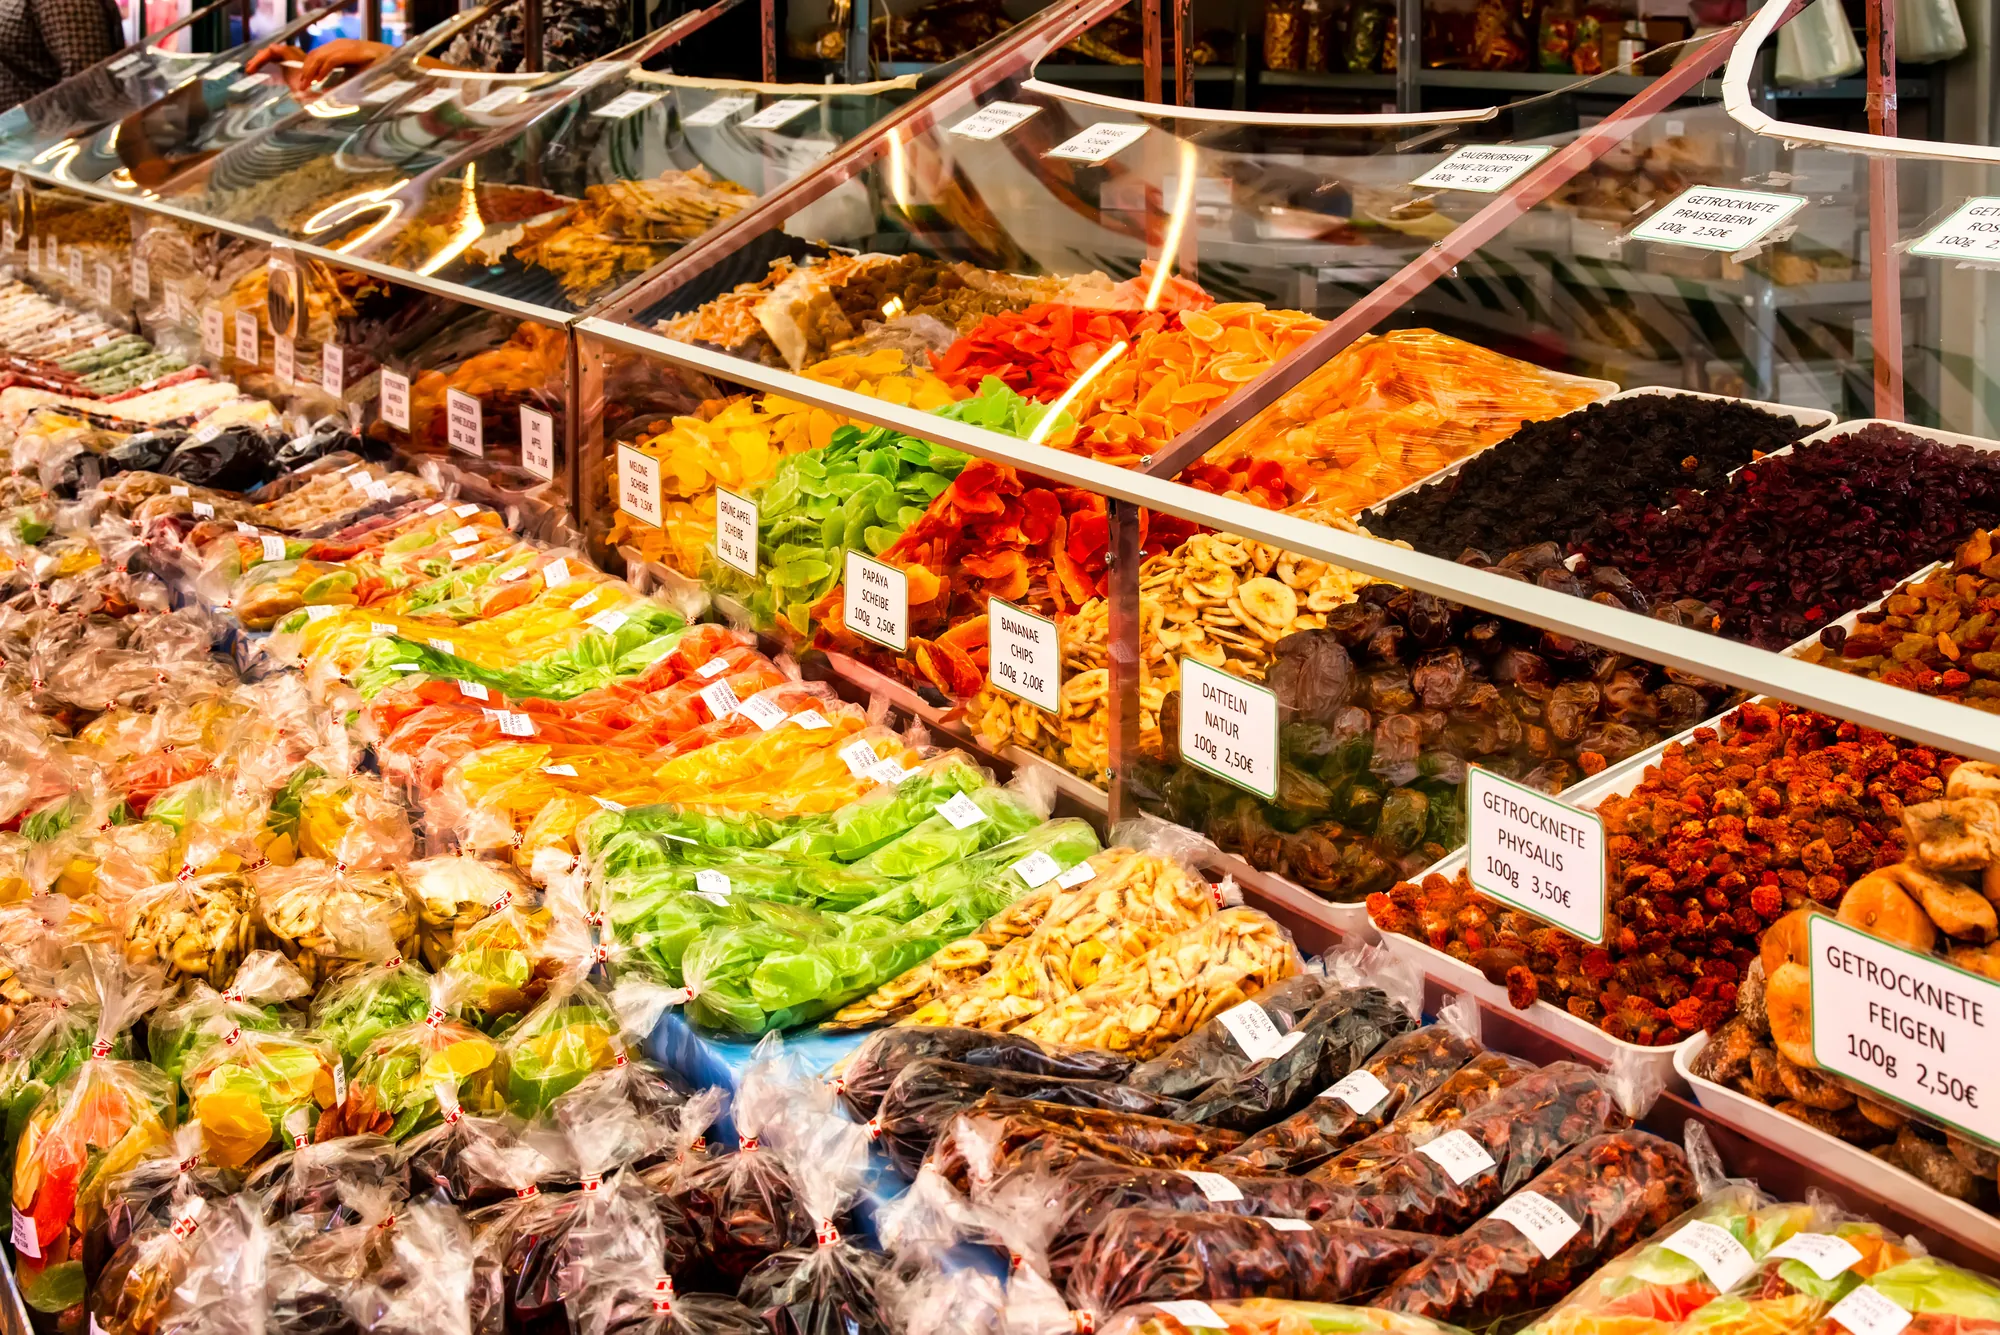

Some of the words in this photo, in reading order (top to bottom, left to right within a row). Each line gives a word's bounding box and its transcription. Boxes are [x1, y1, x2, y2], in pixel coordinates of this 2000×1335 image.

[1443, 163, 1472, 172] OHNE
[1471, 164, 1513, 173] ZUCKER
[1457, 151, 1533, 162] SAUERKIRSHEN
[1430, 174, 1455, 182] 100g
[1461, 175, 1493, 184] 3,50€
[1687, 195, 1780, 214] GETROCKNETE
[1672, 208, 1758, 226] PRAISELBERN
[1655, 221, 1687, 234] 100g
[1692, 226, 1733, 238] 2,50€
[1936, 235, 1976, 248] 100g
[629, 459, 648, 478] MELONE
[630, 477, 649, 495] SCHEIBE
[626, 491, 638, 508] 100g
[640, 497, 653, 514] 2,50€
[720, 501, 736, 518] GRÜNE
[736, 510, 751, 526] APFEL
[724, 521, 743, 541] SCHEIBE
[721, 538, 732, 556] 100g
[735, 546, 748, 562] 2,50€
[862, 589, 889, 611] SCHEIBE
[854, 607, 870, 627] 100g
[876, 616, 896, 635] 2,50€
[1001, 616, 1039, 644] BANANAE
[1010, 643, 1034, 664] CHIPS
[999, 661, 1017, 683] 100g
[1022, 671, 1044, 692] 2,00€
[1202, 682, 1247, 715] DATTELN
[1205, 710, 1239, 740] NATUR
[1194, 733, 1217, 760] 100g
[1225, 748, 1254, 774] 2,50€
[1483, 791, 1585, 849] GETROCKNETE
[1498, 828, 1564, 872] PHYSALIS
[1487, 855, 1519, 889] 100g
[1531, 875, 1571, 909] 3,50€
[1826, 945, 1984, 1028] GETROCKNETE
[1869, 1001, 1945, 1053] FEIGEN
[1847, 1033, 1897, 1079] 100g
[1916, 1063, 1979, 1109] 2,50€
